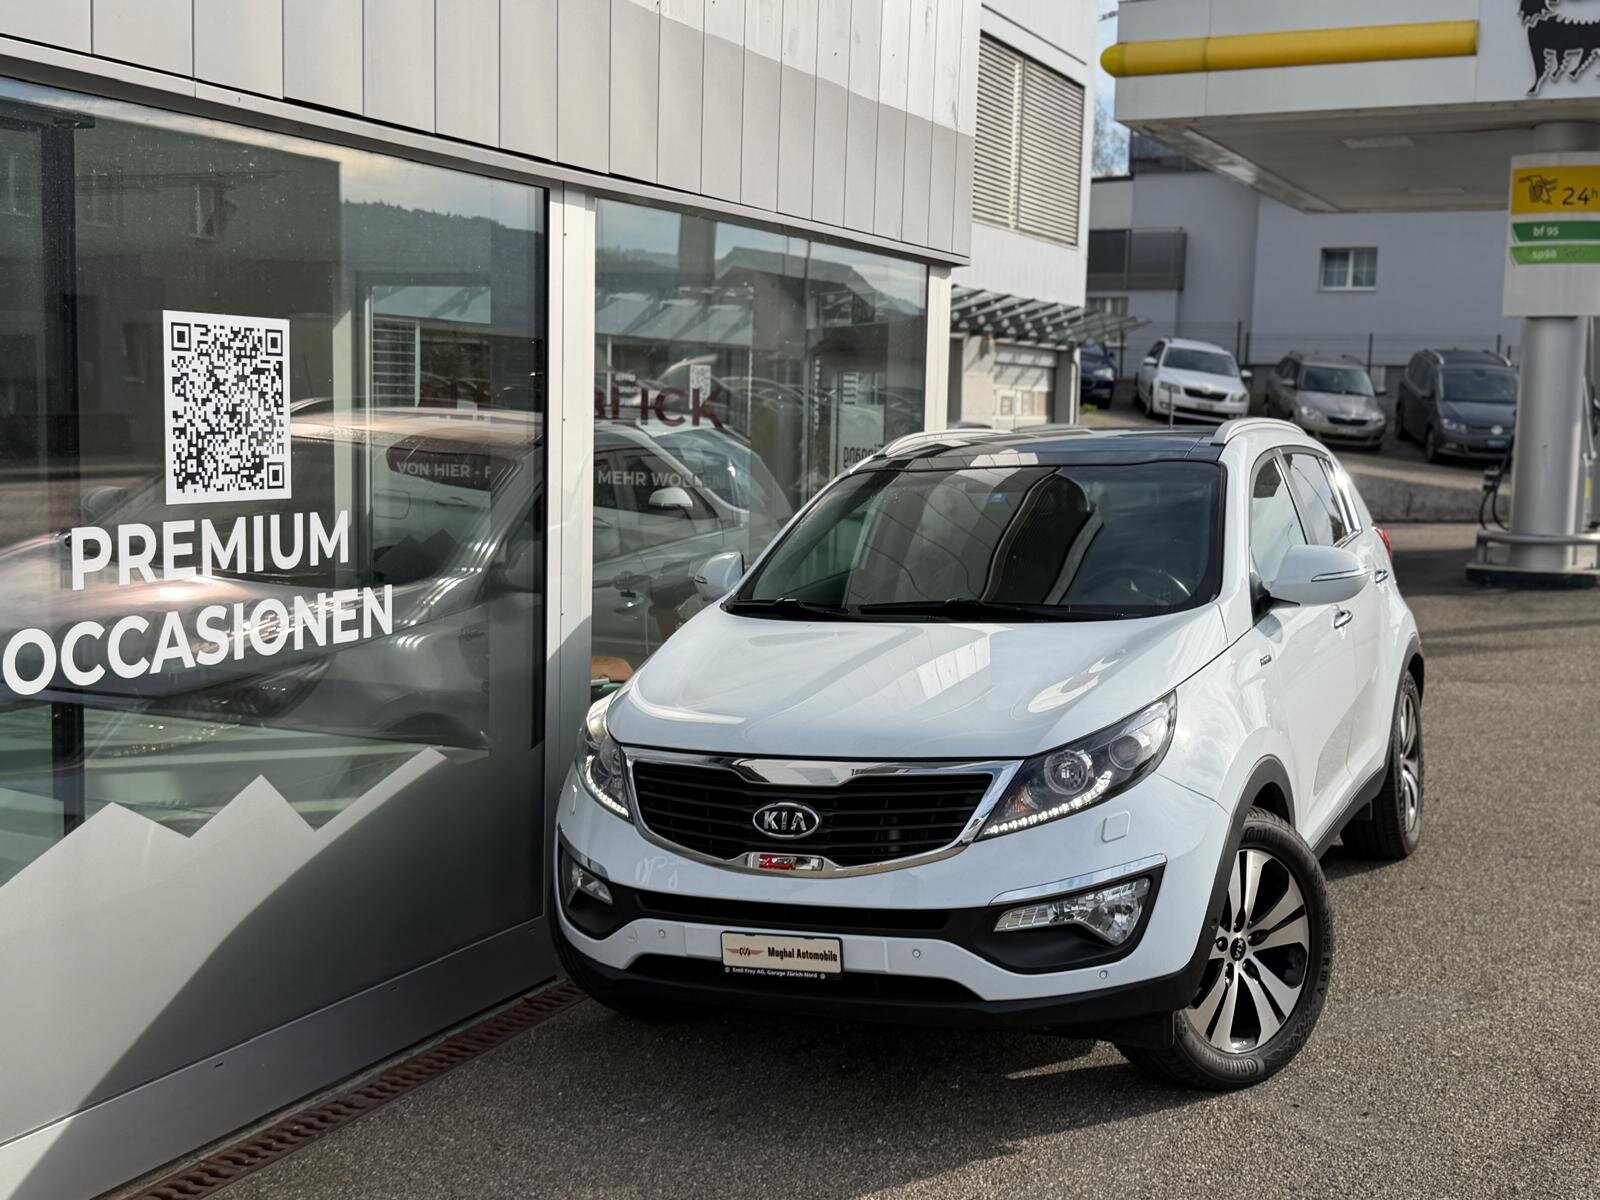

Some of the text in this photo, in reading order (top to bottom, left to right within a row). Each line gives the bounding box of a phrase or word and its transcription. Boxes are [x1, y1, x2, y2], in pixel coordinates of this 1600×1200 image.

[396, 461, 429, 477] VON
[434, 463, 470, 478] HIER
[598, 471, 646, 486] MEHR
[71, 510, 349, 591] PREMIUM
[2, 584, 393, 695] OCCASIONEN
[763, 811, 807, 831] KIA
[768, 947, 838, 962] Mughal Automobile
[744, 968, 756, 976] Frey
